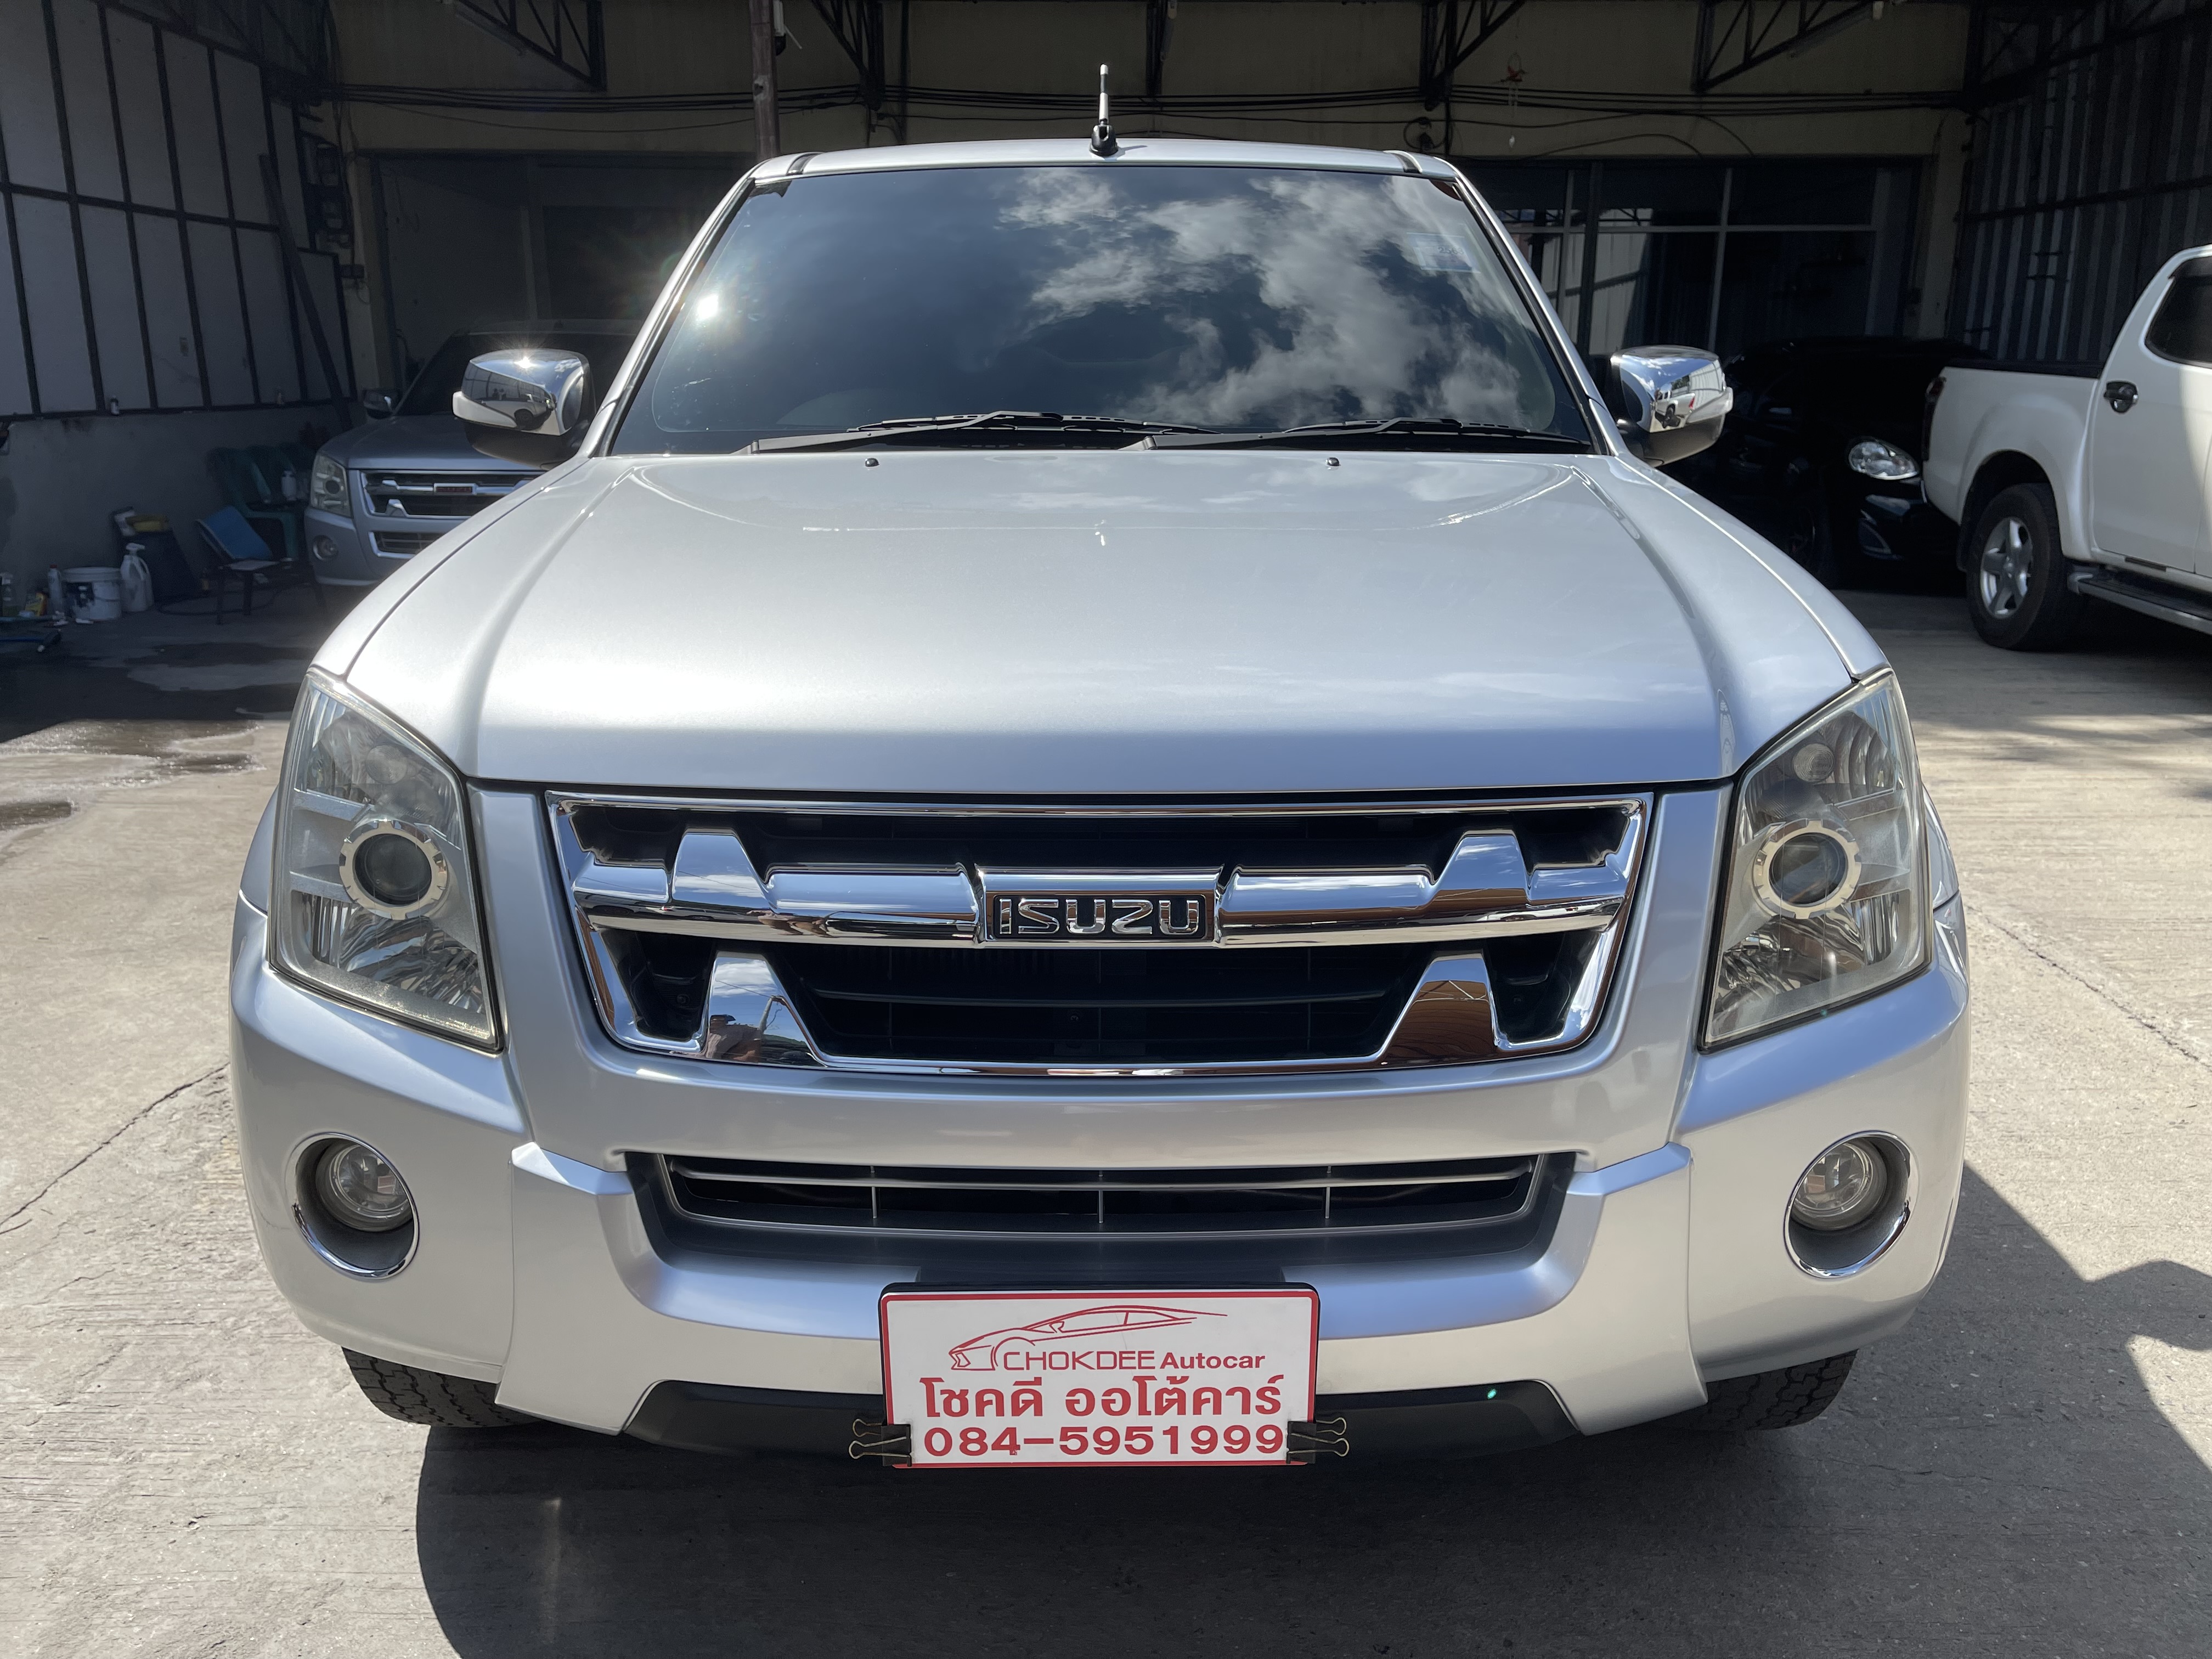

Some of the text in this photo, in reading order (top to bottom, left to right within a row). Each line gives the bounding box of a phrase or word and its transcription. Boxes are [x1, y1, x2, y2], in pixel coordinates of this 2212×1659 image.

[999, 898, 1199, 935] ISUZU
[1003, 1351, 1265, 1370] CHOKDEE Autocar
[919, 1374, 1284, 1418] โชคดี ออโต้คาร์
[924, 1425, 1284, 1457] 084-5951999
